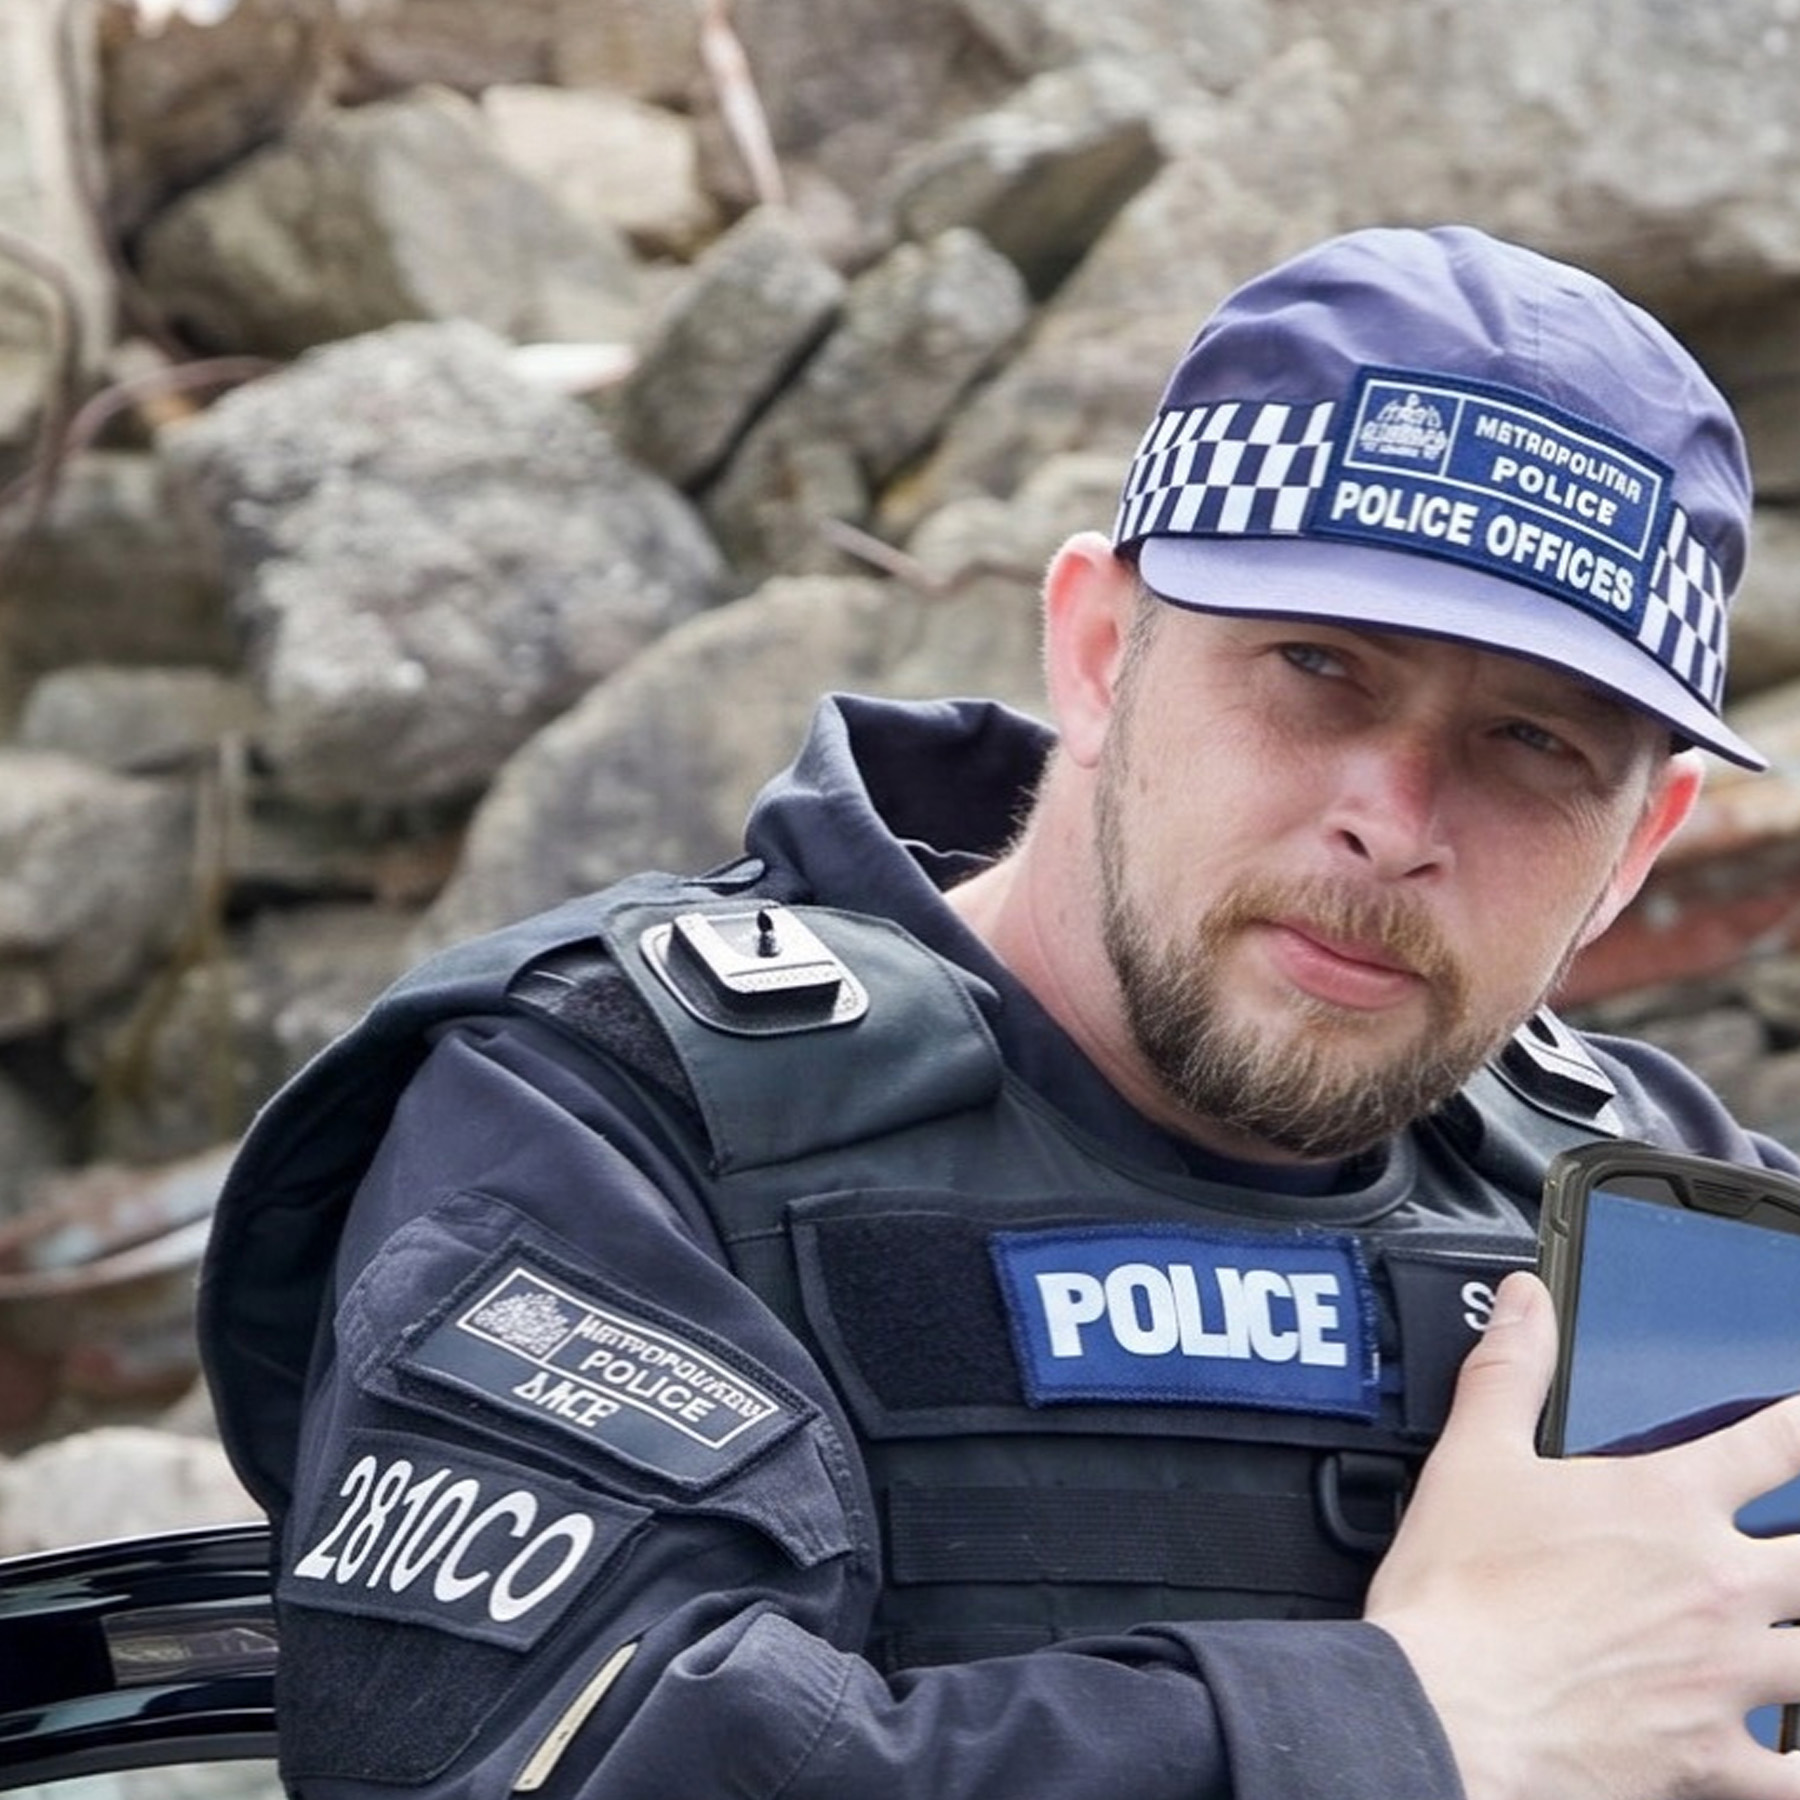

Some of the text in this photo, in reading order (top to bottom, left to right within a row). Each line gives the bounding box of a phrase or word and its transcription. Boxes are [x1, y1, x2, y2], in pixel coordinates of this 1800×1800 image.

[1490, 455, 1618, 526] POLICE
[1330, 481, 1636, 613] POLICE OFFICES
[1034, 1263, 1348, 1367] POLICE
[578, 1349, 718, 1423] POLICE
[293, 1454, 596, 1623] 2810CO
